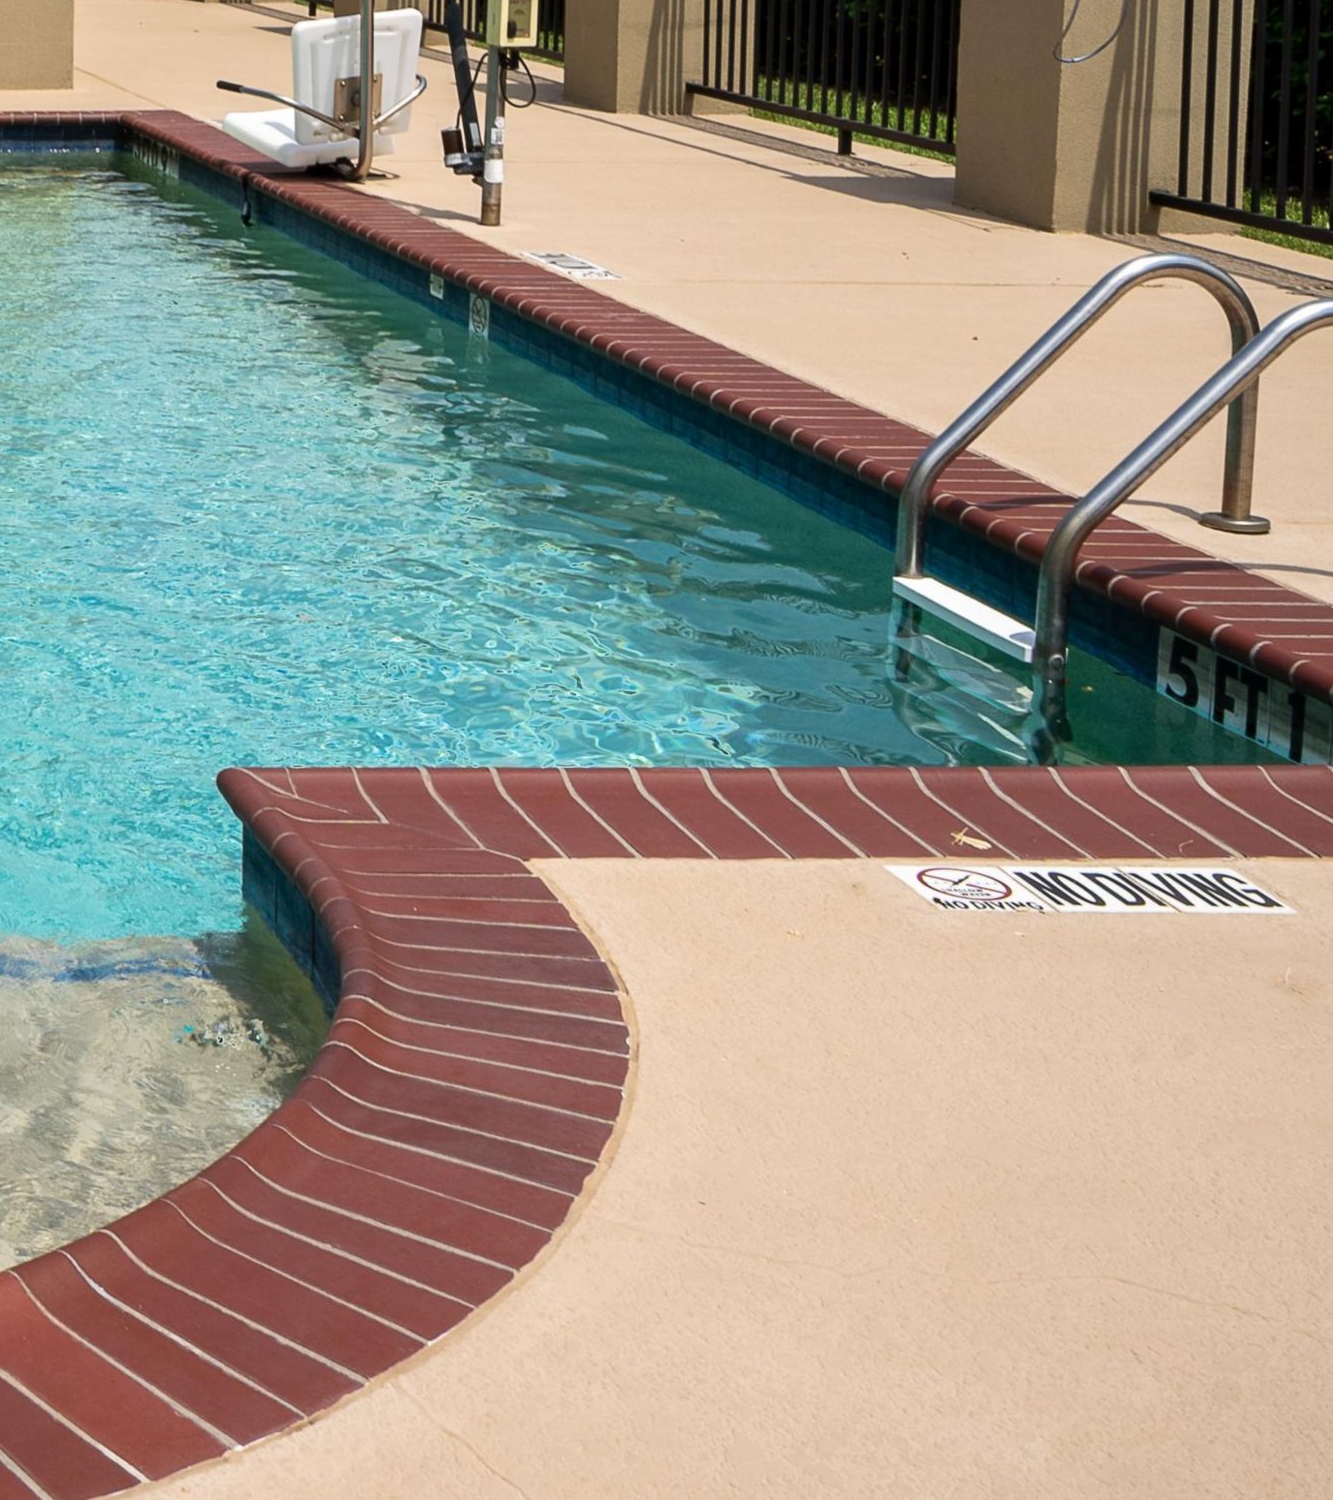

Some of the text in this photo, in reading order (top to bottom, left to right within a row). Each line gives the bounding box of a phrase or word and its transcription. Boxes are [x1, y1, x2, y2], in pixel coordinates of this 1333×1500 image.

[1013, 871, 1284, 908] NO DIVING
[939, 899, 1045, 914] NO DIVING
